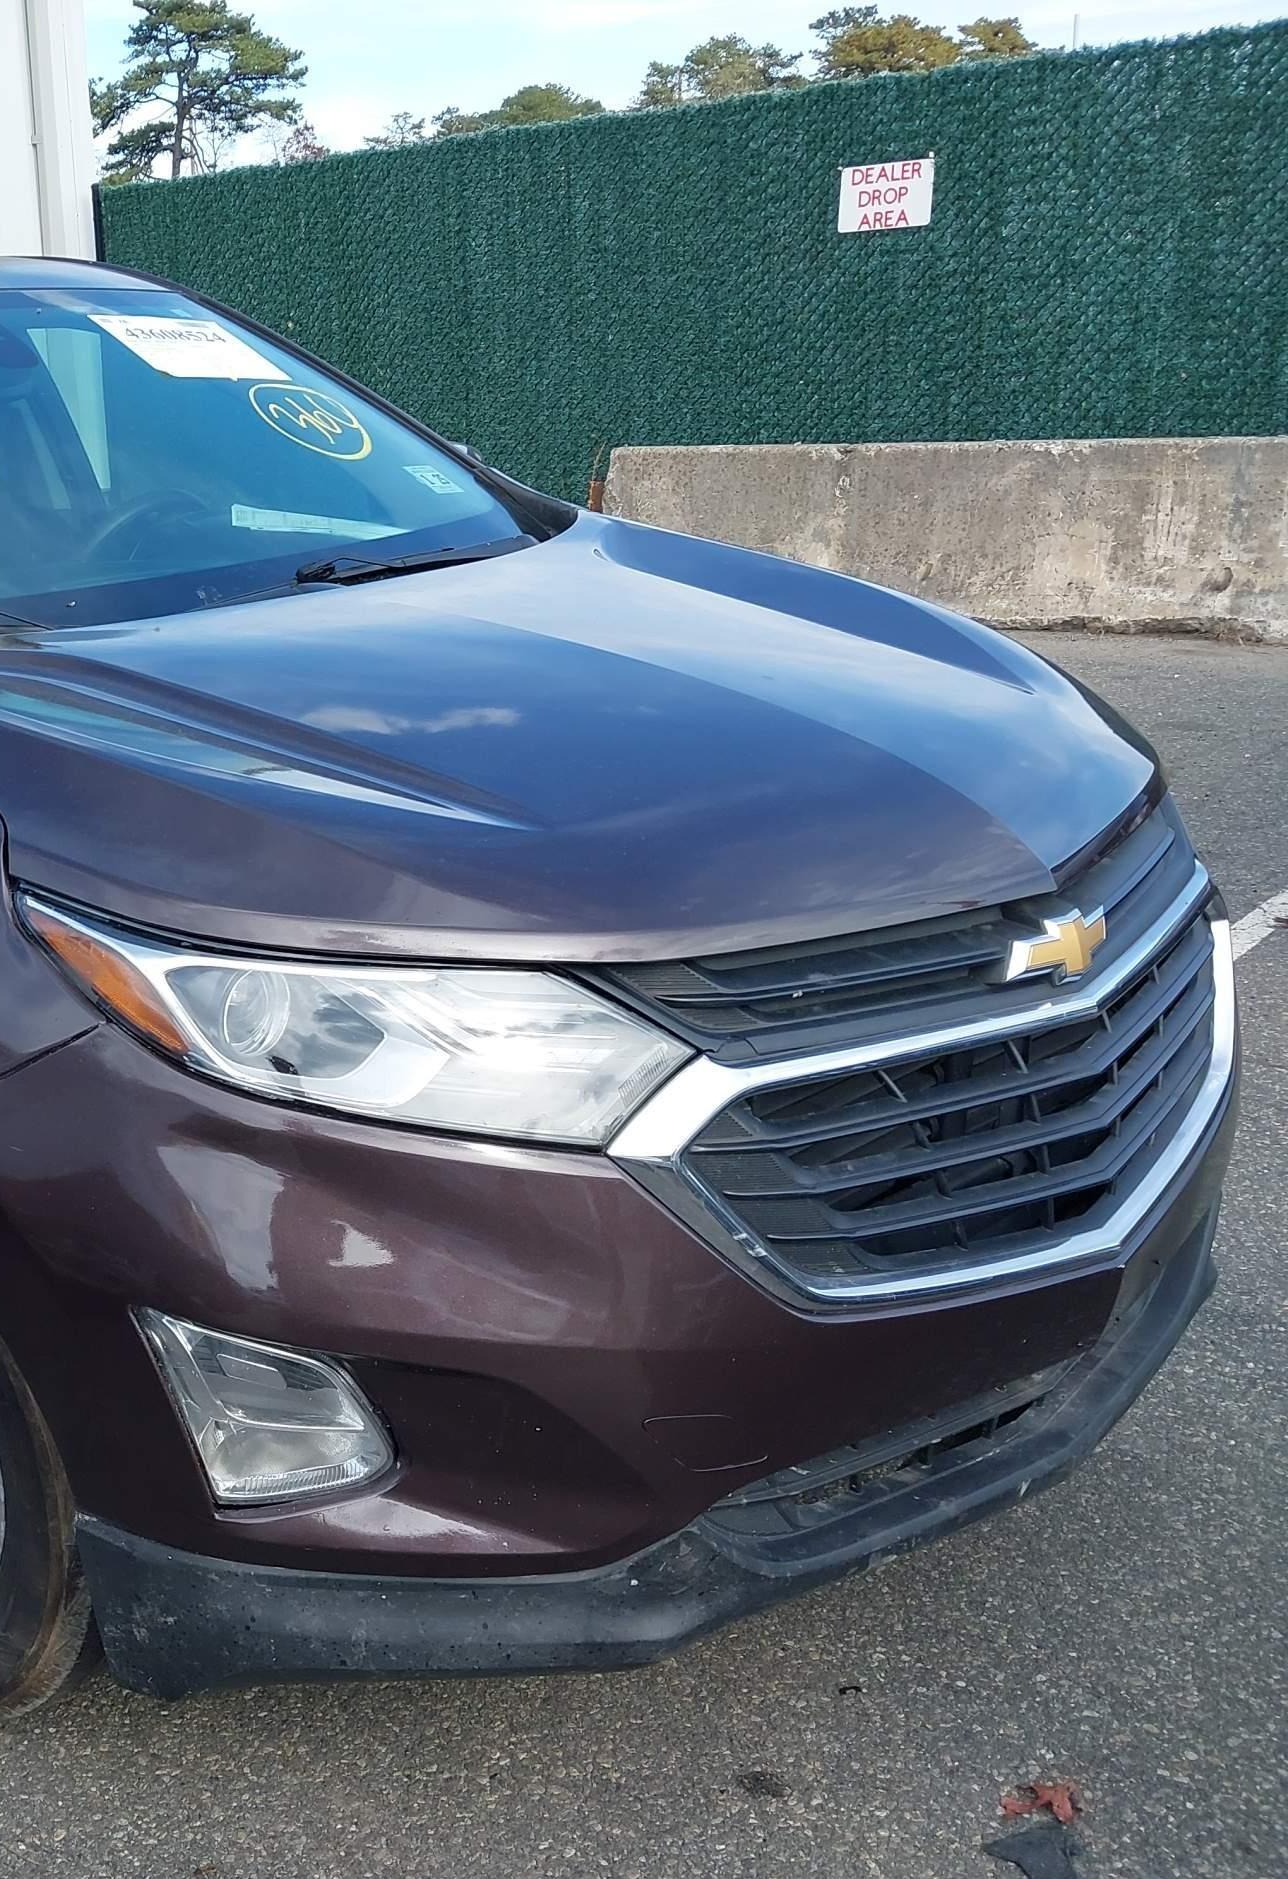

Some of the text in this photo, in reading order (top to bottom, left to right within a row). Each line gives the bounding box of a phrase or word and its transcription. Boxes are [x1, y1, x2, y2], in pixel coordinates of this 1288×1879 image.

[851, 161, 923, 186] DEALER
[858, 186, 909, 208] DROP
[857, 209, 910, 231] AREA
[125, 327, 227, 343] 43608524
